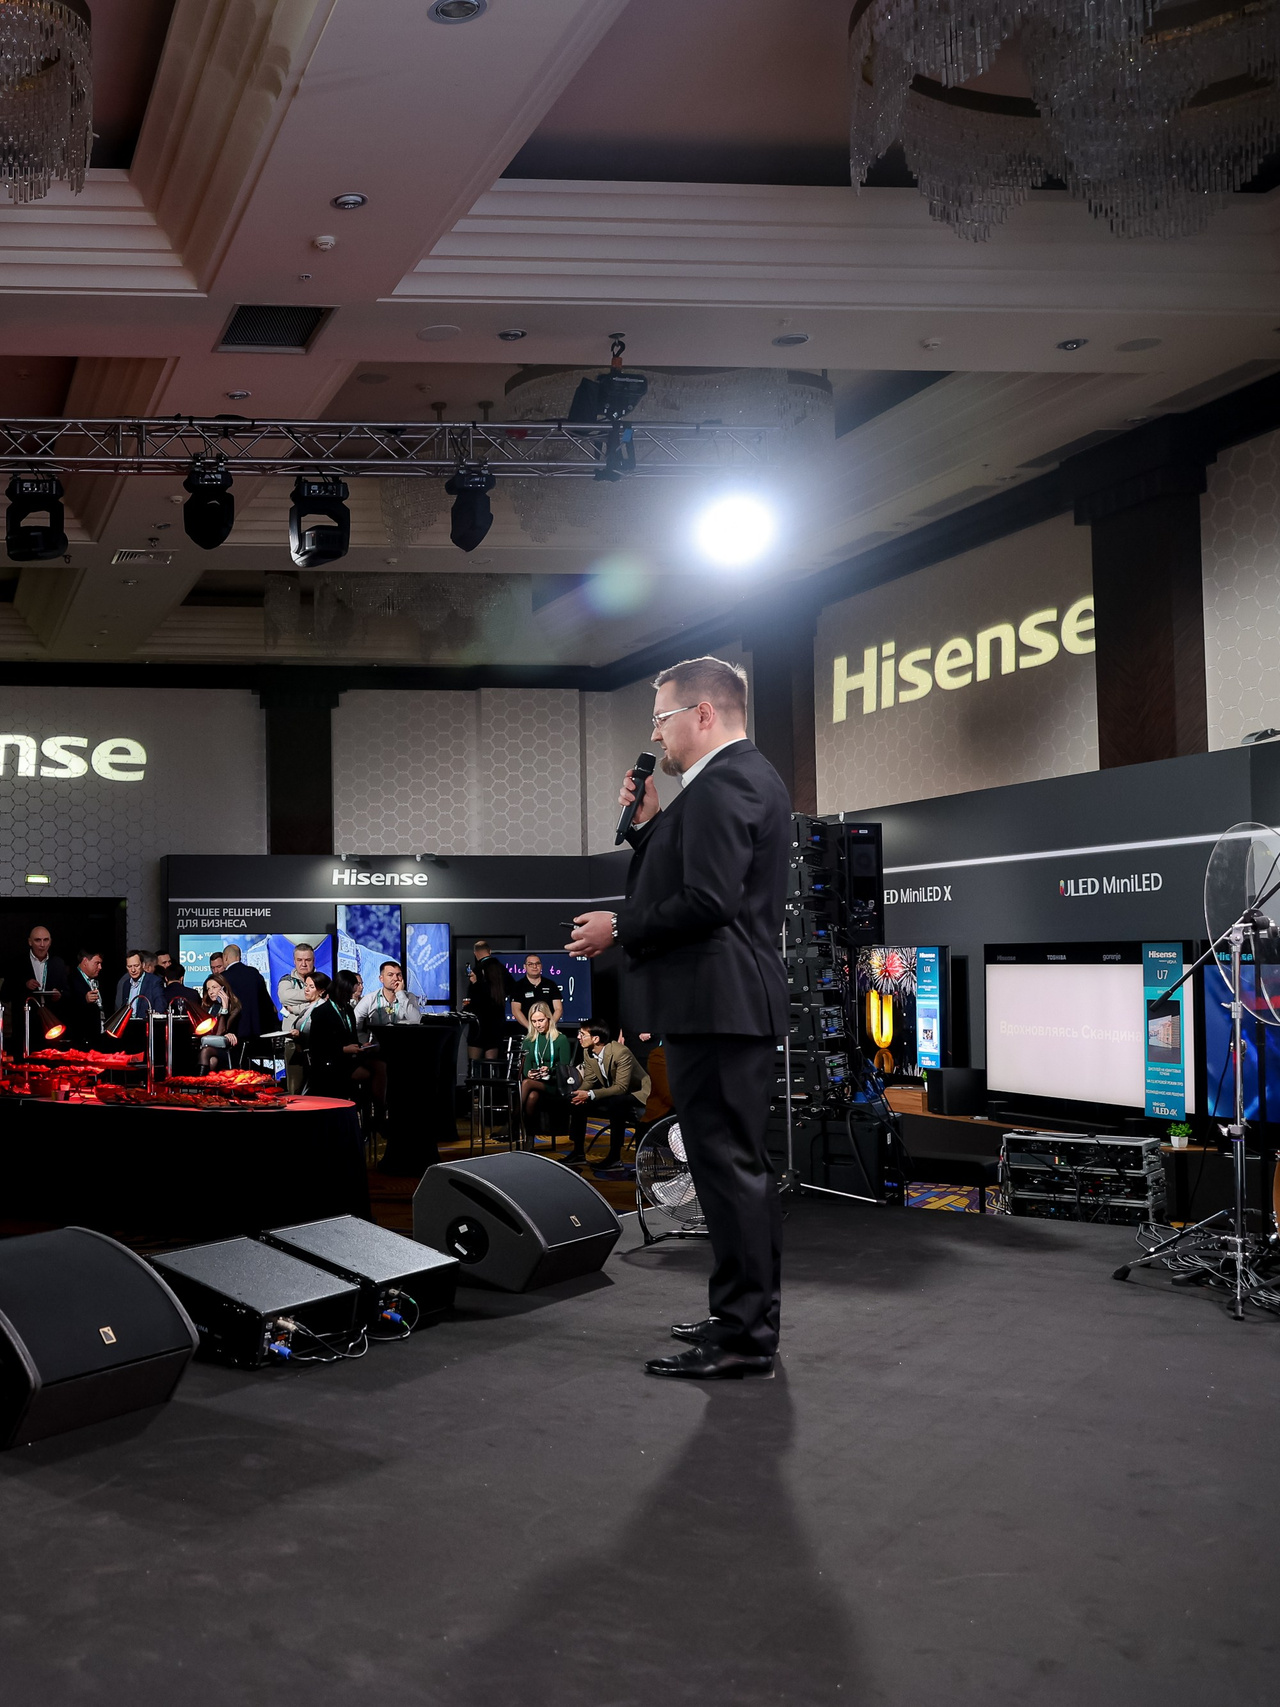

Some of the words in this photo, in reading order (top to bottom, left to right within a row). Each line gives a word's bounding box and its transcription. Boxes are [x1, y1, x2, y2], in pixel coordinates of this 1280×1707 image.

[832, 595, 1096, 724] Hisense
[332, 868, 429, 886] Hisense
[1059, 877, 1100, 897] ULED
[1102, 872, 1163, 895] MiniLED
[883, 889, 899, 905] ED
[900, 886, 942, 904] MiniLED
[943, 885, 952, 901] X
[176, 908, 220, 917] ЛУЧШЕЕ
[222, 908, 272, 917] РЕШЕНИЕ
[176, 919, 199, 930] ДЛЯ
[200, 919, 248, 929] БИЗНЕСА
[179, 950, 204, 964] 50+
[1148, 950, 1177, 959] Hisense
[1157, 969, 1169, 980] U7
[1000, 1020, 1079, 1039] Вдохновляясь
[1081, 1024, 1143, 1043] Скандина
